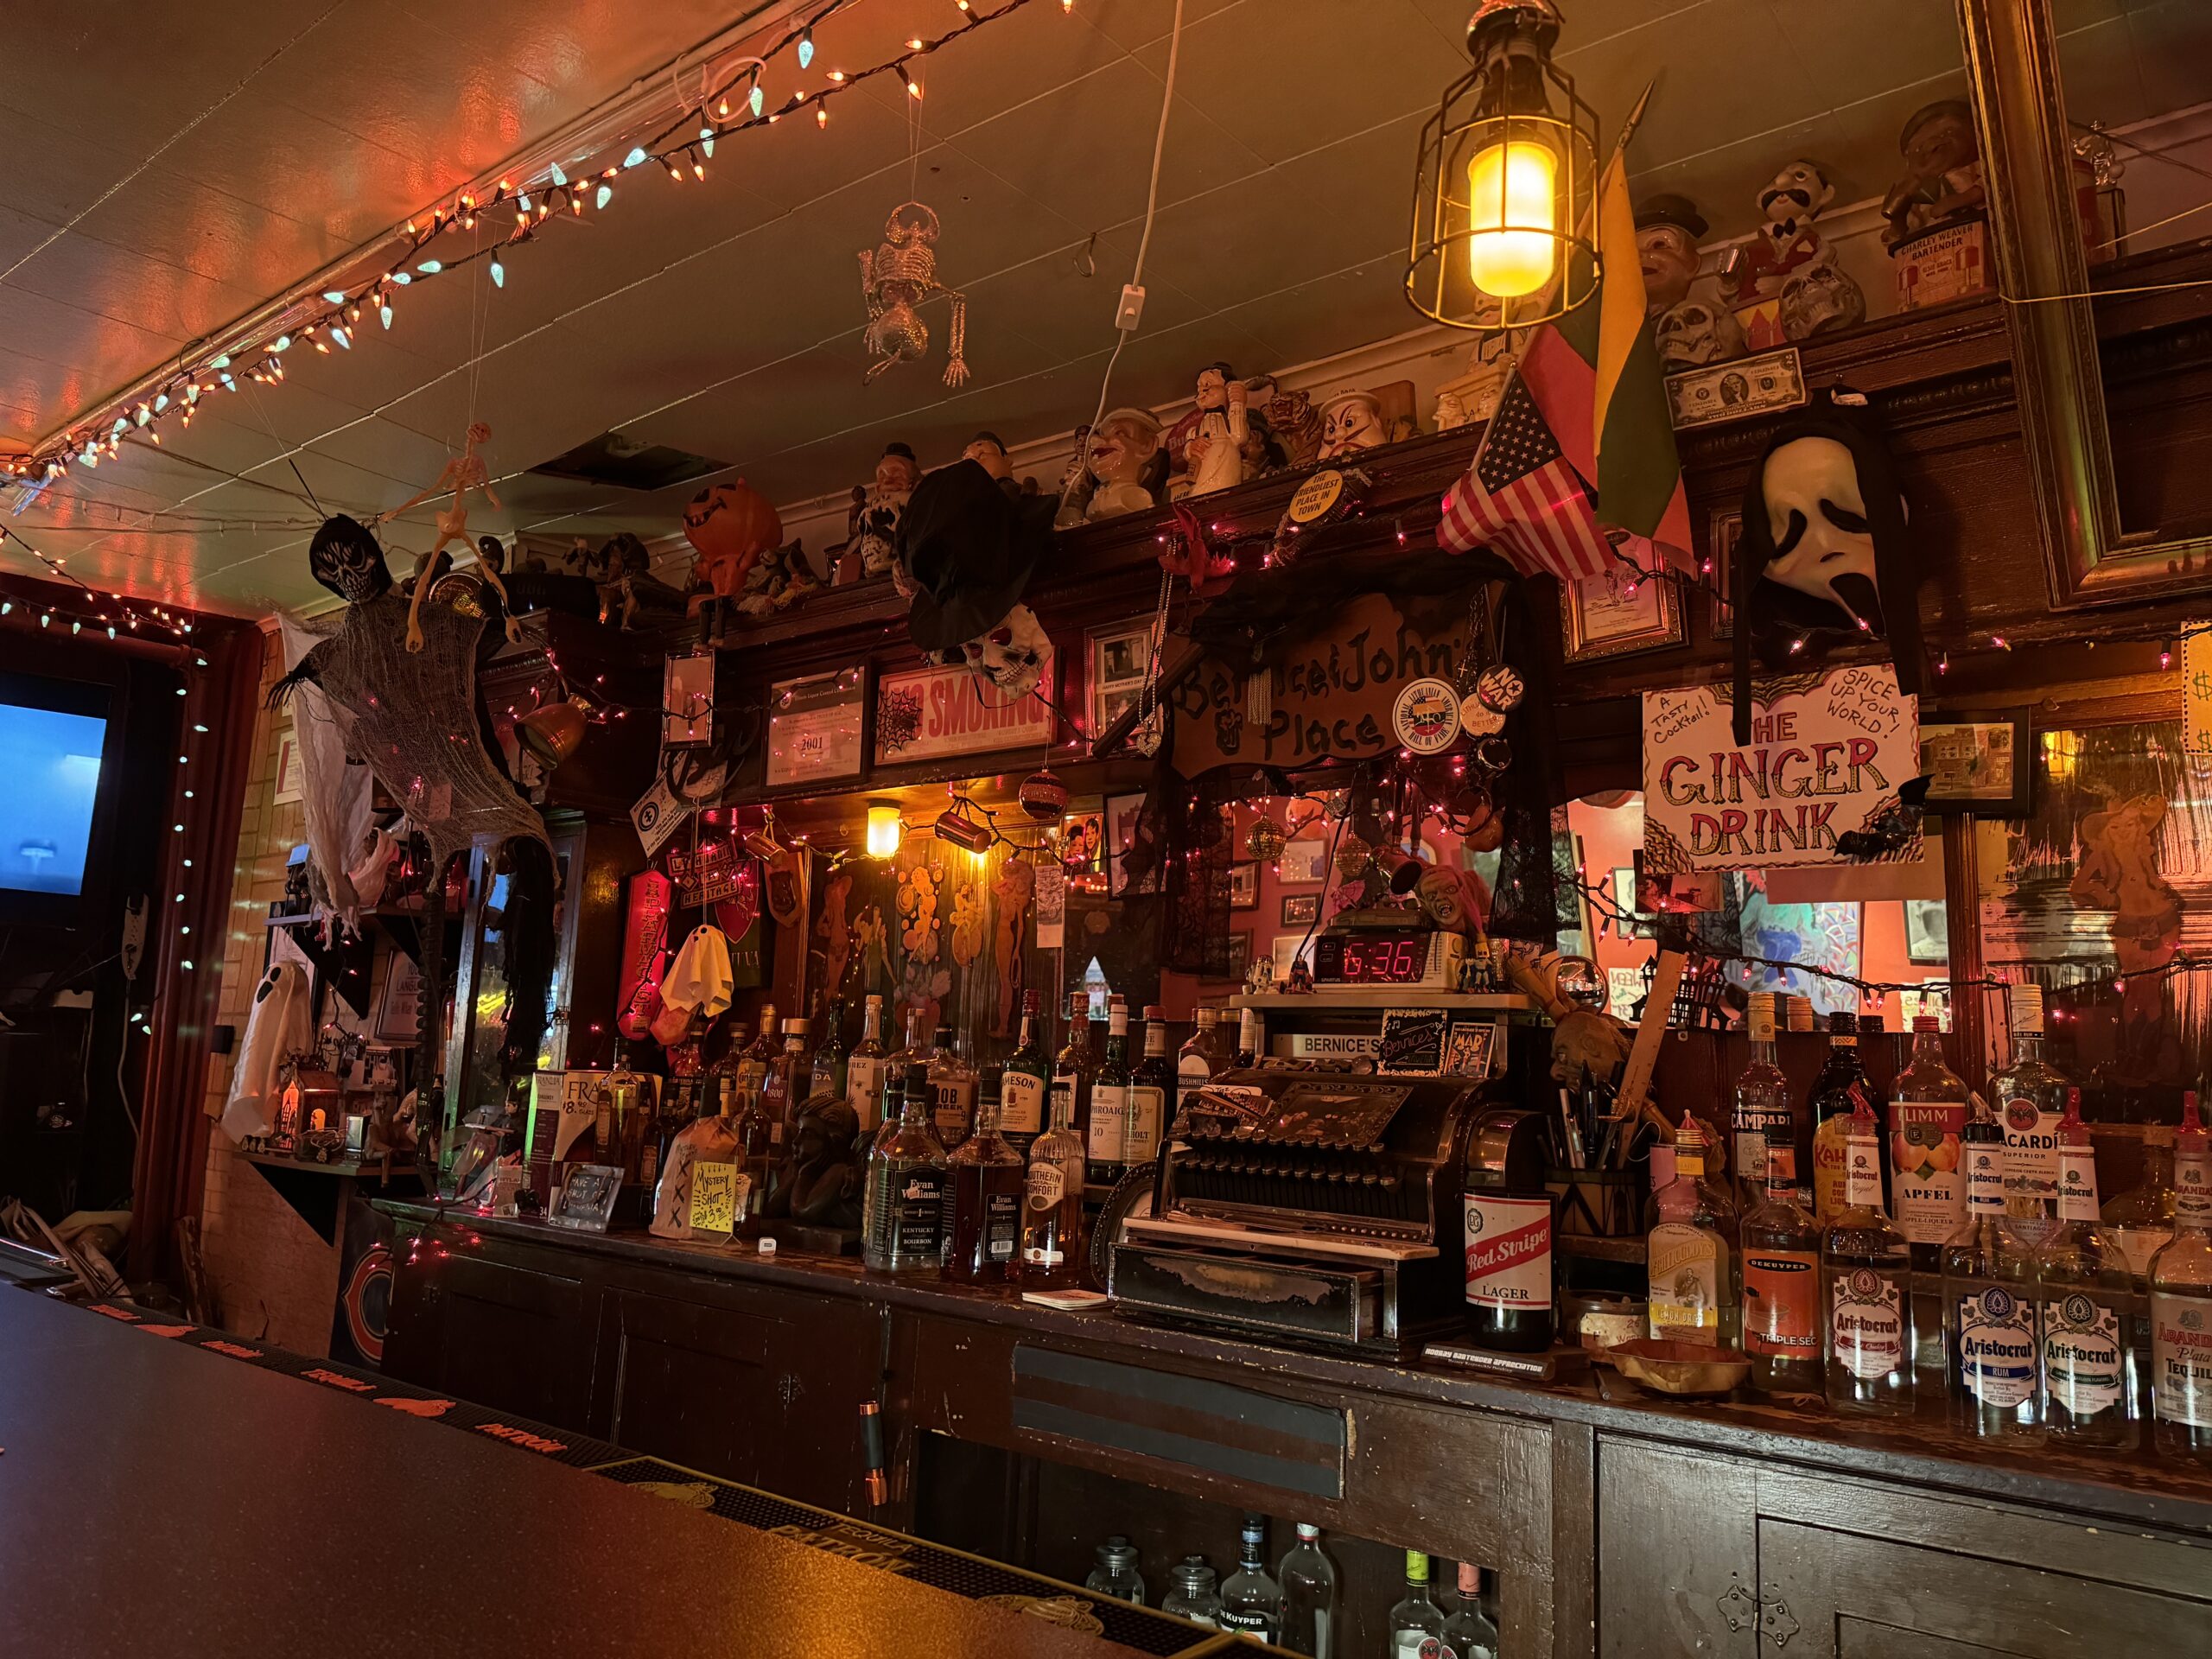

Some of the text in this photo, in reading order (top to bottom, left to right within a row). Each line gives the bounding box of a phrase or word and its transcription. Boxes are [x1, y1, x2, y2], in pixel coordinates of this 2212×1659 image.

[1902, 225, 1974, 256] CHARLEY WEAVER
[1912, 238, 1962, 261] BARTENDER
[1313, 472, 1326, 482] THE
[1295, 479, 1338, 499] FRIENDLIEST
[1296, 491, 1330, 507] PLACE IN
[1298, 503, 1321, 517] TOWN
[1494, 666, 1524, 696] NO
[1843, 670, 1897, 701] SPICE
[1480, 672, 1513, 713] WAR
[1659, 697, 1670, 709] A
[1830, 682, 1899, 720] UP YOUR
[1651, 701, 1688, 727] TASTY
[1654, 696, 1710, 744] Cocktail!
[1754, 712, 1797, 744] HE
[801, 736, 823, 751] 2001
[1660, 737, 1889, 806] GINGER
[1689, 802, 1839, 856] DRINK
[684, 882, 736, 905] HERITAGE
[1344, 941, 1414, 976] 6:36
[1306, 1038, 1380, 1052] BERNICE'S
[1178, 1077, 1209, 1086] BUSHMILLS
[767, 1088, 783, 1098] 1800
[1731, 1112, 1790, 1130] CAMPARI
[1094, 1127, 1103, 1137] 10
[2003, 1151, 2046, 1160] SUPERIOR
[695, 1169, 729, 1192] MYSTERY
[910, 1179, 934, 1191] Evan
[1846, 1171, 1878, 1185] Aristocrat
[1967, 1172, 2002, 1185] Aristocrat
[702, 1192, 723, 1205] SHOT
[901, 1188, 941, 1200] Wliams
[995, 1195, 1012, 1204] Evan
[1903, 1188, 1953, 1201] APFEL
[2057, 1185, 2094, 1198] Aristocrat
[990, 1203, 1017, 1212] Williams
[902, 1226, 935, 1235] KENTUCKY
[1467, 1228, 1548, 1273] Red Stripe
[1483, 1285, 1529, 1300] LAGER
[1836, 1313, 1898, 1333] Aristocrat
[1759, 1332, 1817, 1346] TRIPLE SEC
[2158, 1321, 2212, 1348] ARAND
[1965, 1337, 2032, 1358] Aristocrat
[2047, 1340, 2116, 1364] Aristocrat
[2177, 1347, 2212, 1363] Plata
[1992, 1367, 2010, 1378] RUM
[2166, 1357, 2212, 1380] TEQUIL
[830, 1522, 914, 1553] TEQUILA
